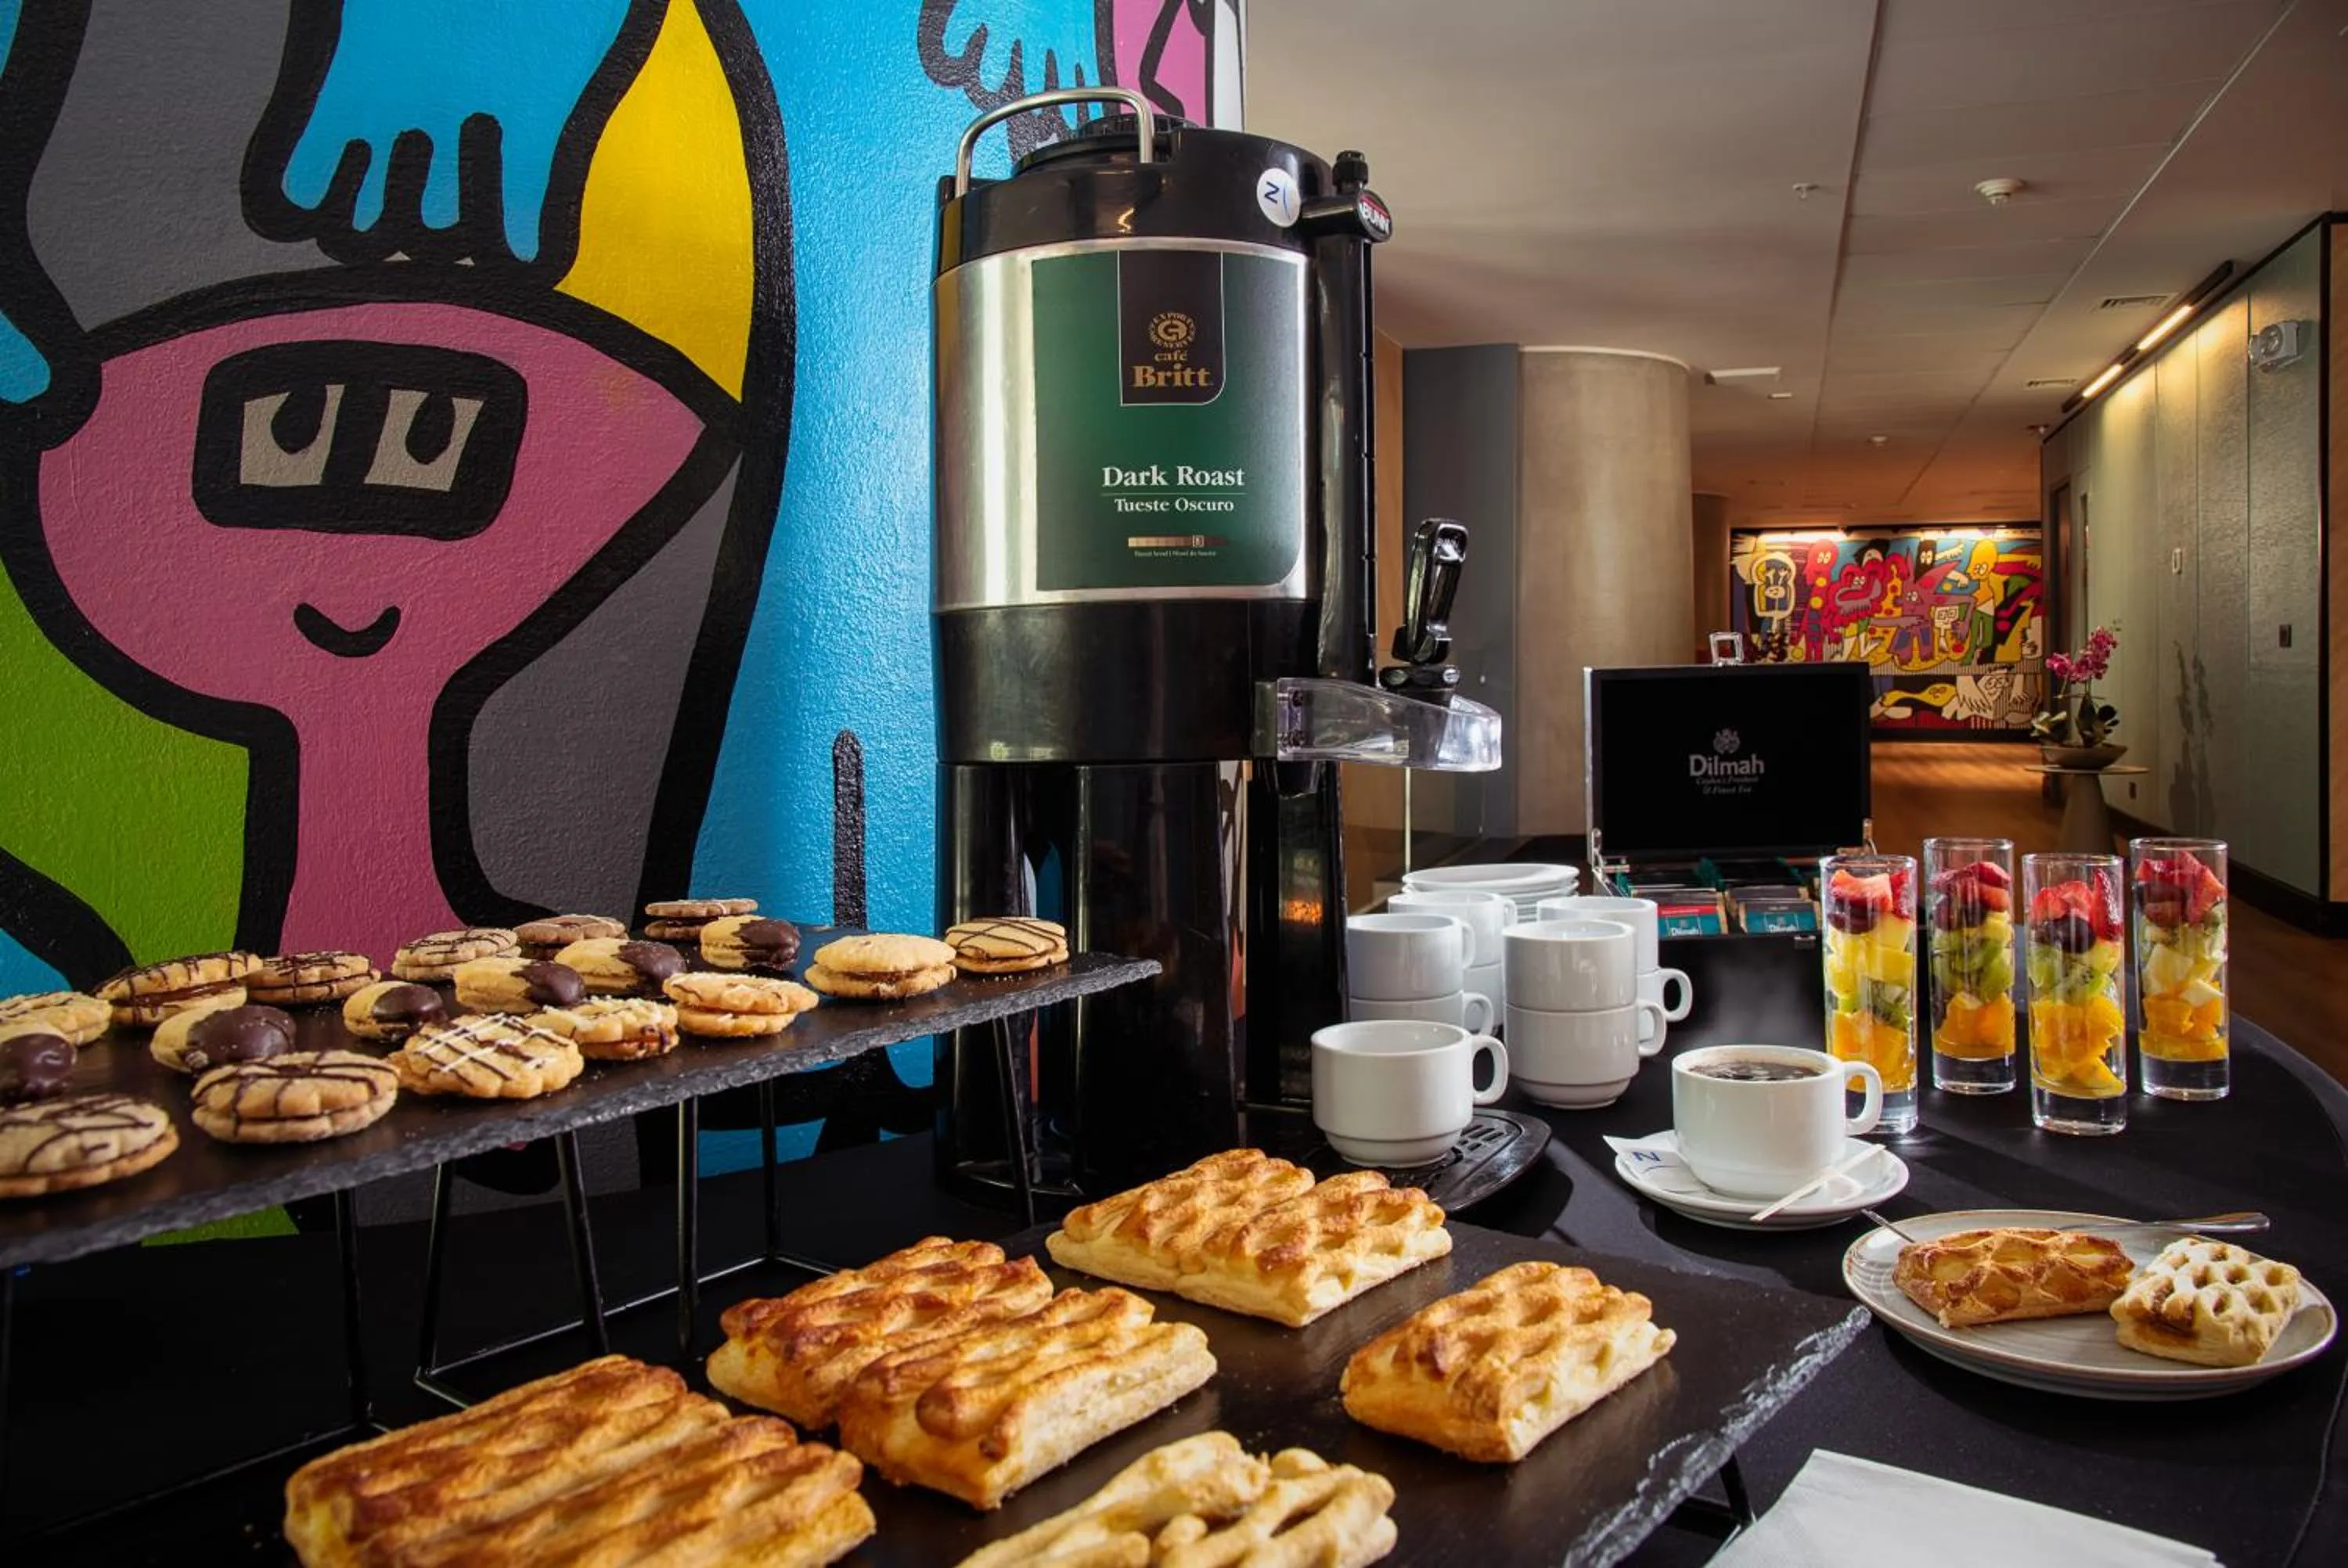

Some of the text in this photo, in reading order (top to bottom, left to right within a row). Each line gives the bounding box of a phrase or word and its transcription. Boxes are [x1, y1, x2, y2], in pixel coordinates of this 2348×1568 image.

[1154, 350, 1187, 361] café
[1133, 363, 1211, 387] Britt
[1102, 465, 1246, 486] Dark Roast
[1114, 498, 1234, 512] Tueste Oscuro
[1689, 753, 1764, 776] Dilmah
